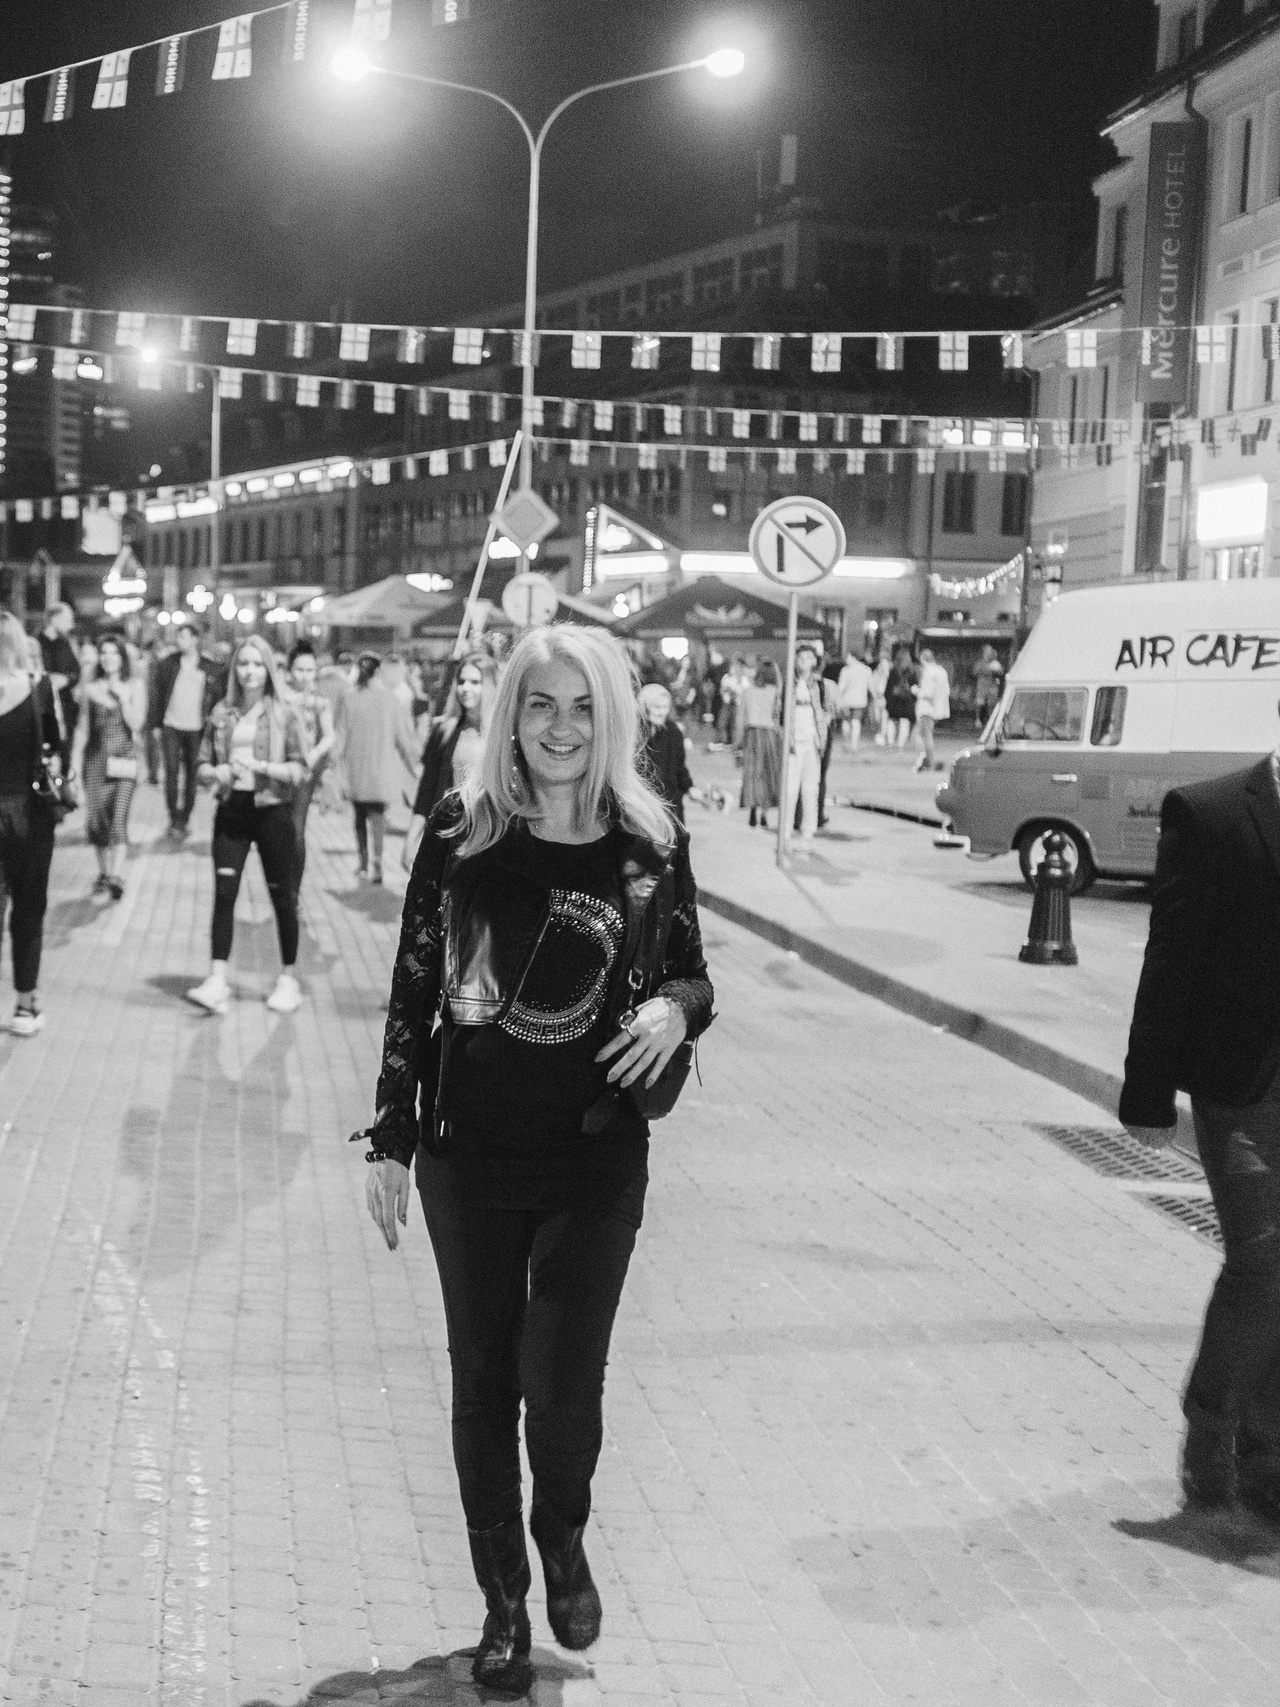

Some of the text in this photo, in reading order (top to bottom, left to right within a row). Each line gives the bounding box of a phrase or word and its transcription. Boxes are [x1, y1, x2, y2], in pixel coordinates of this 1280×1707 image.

[163, 37, 181, 93] BORJOMI
[52, 68, 69, 121] BORJOMI
[1149, 145, 1186, 378] Mercure HOTEL
[1115, 633, 1280, 671] AIR CAFE
